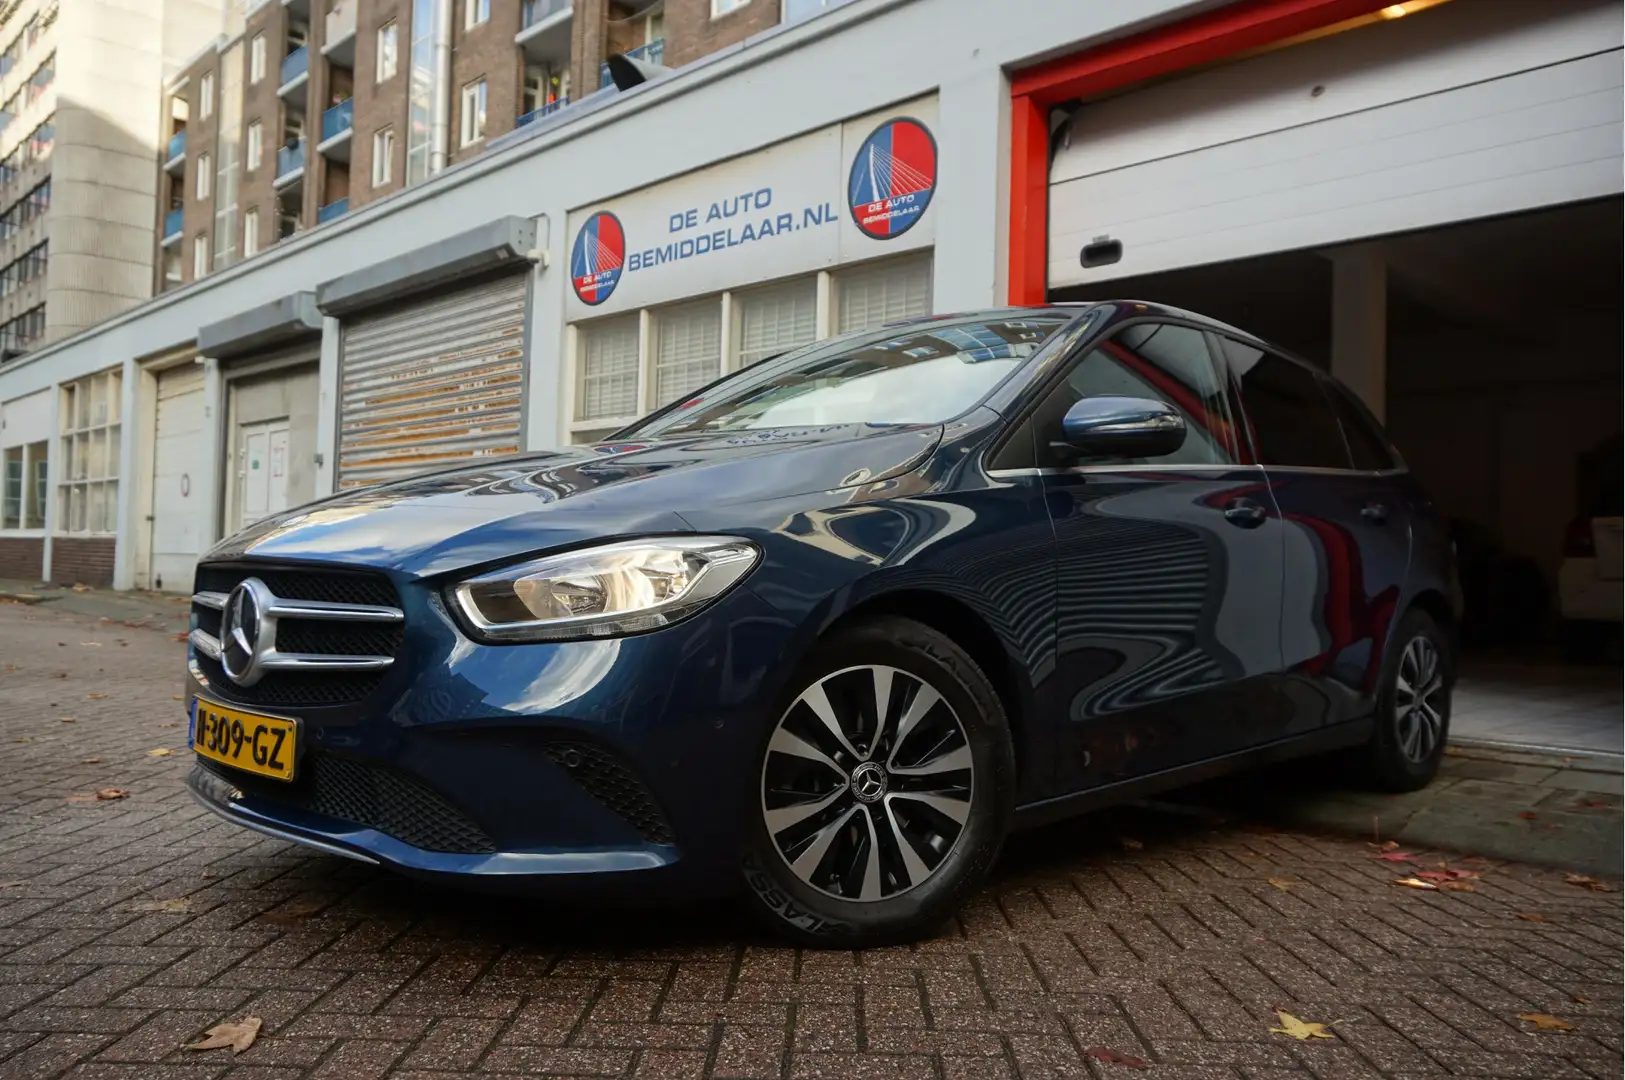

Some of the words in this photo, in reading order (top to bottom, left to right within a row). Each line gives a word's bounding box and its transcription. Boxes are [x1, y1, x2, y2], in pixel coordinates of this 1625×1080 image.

[669, 208, 698, 233] DE
[706, 187, 772, 224] AUTO
[868, 202, 883, 213] DE
[885, 194, 915, 209] AUTO
[628, 202, 839, 272] BEMIDDELAAR.NL
[196, 708, 286, 771] H-309-GZ
